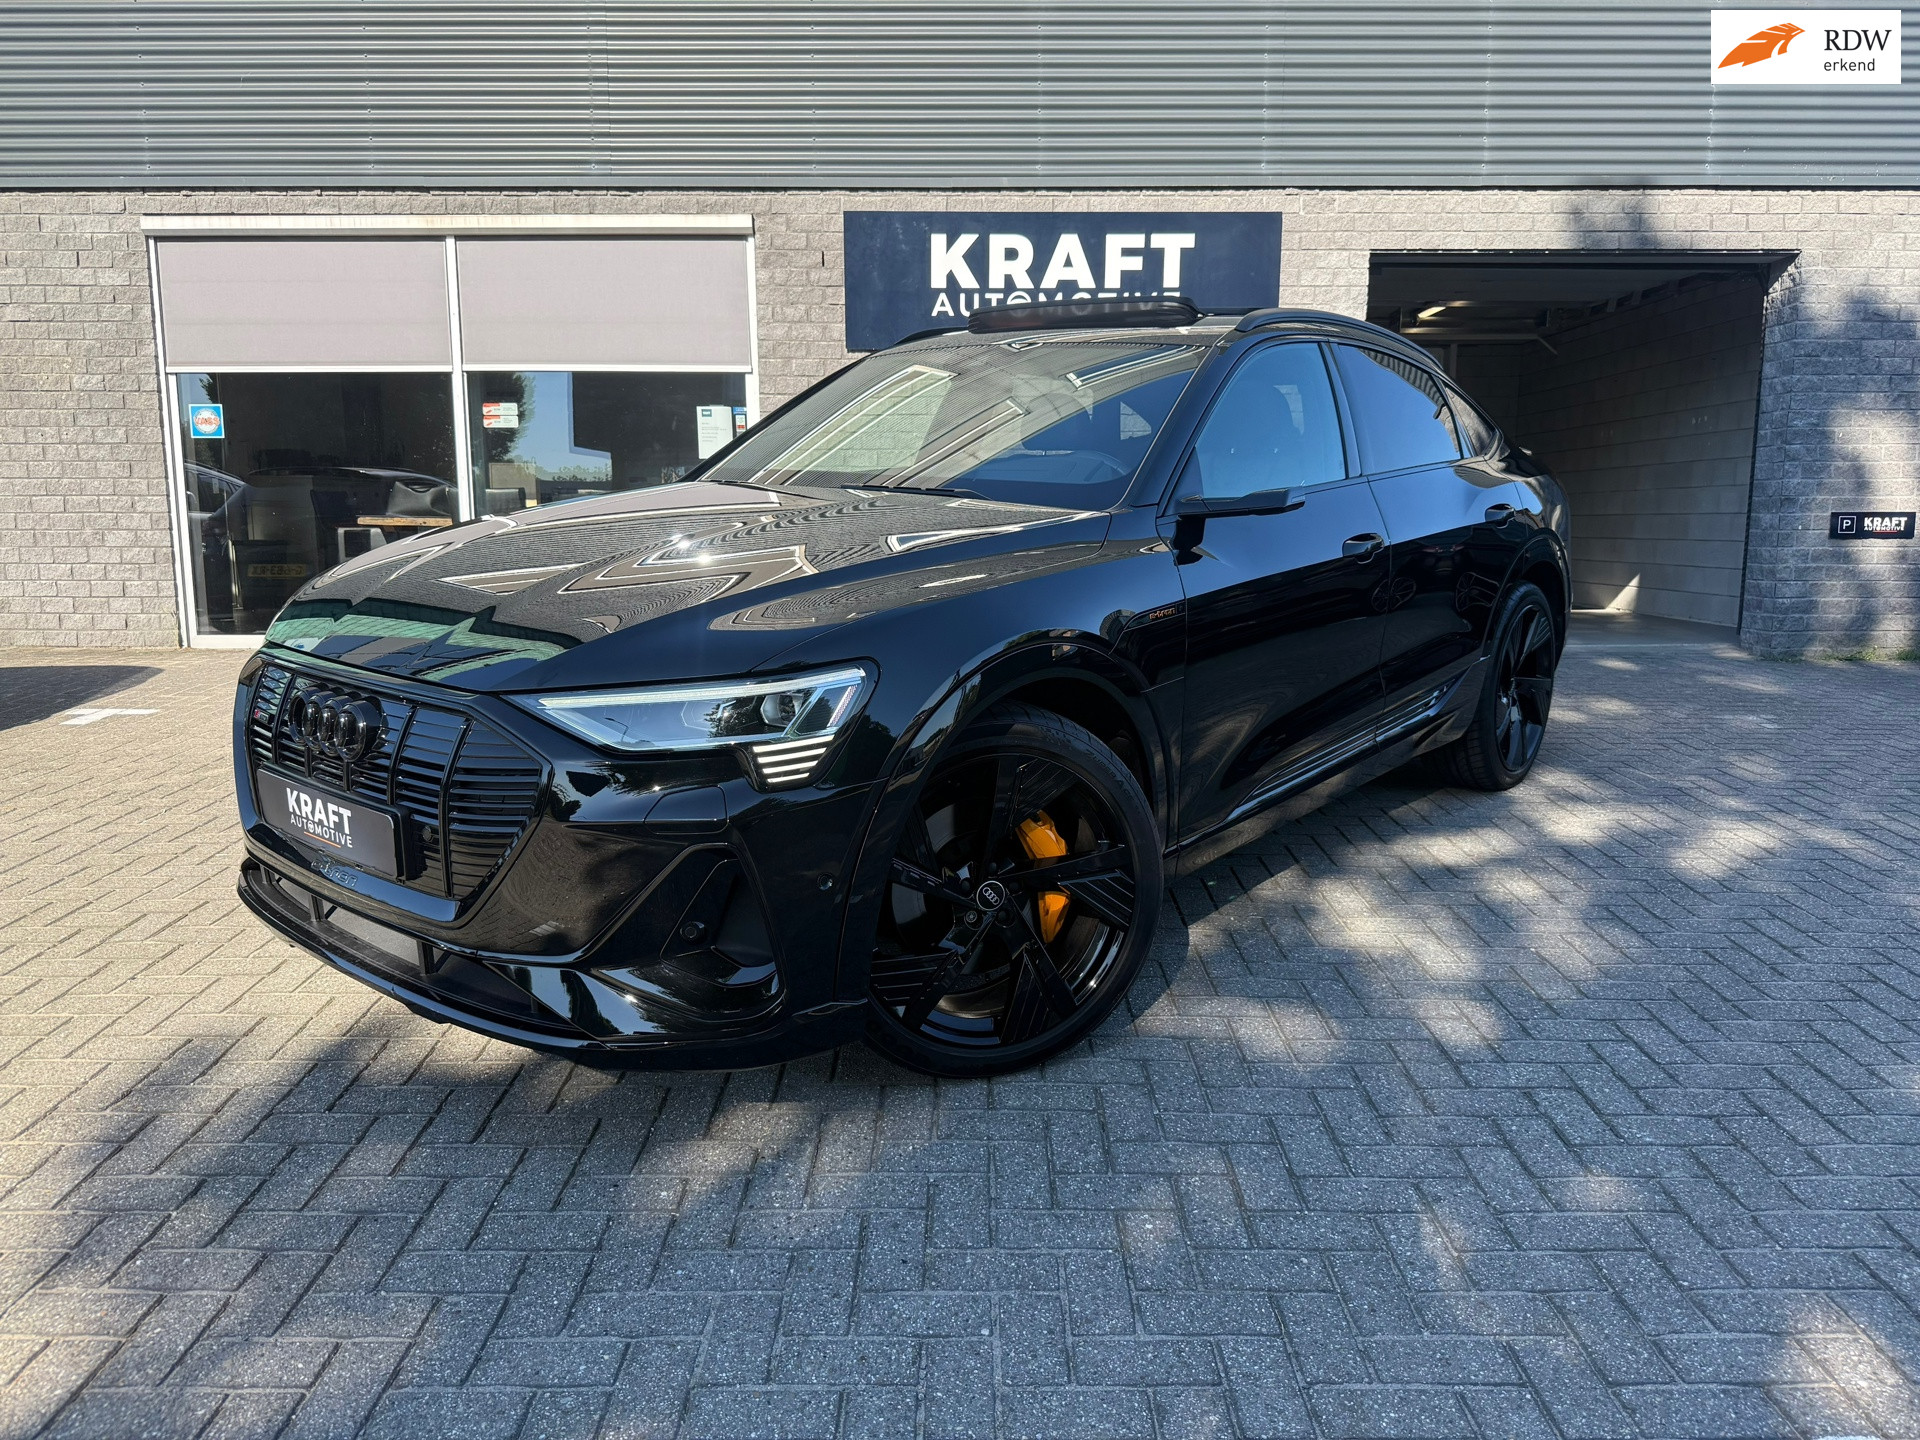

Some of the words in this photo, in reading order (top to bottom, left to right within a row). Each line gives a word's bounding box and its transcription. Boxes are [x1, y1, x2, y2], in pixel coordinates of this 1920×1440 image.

[930, 233, 1196, 289] KRAFT
[1842, 519, 1852, 530] P
[1864, 517, 1908, 528] KRAFT
[286, 787, 352, 835] KRAFT
[290, 813, 353, 849] AUTOMOTIVE
